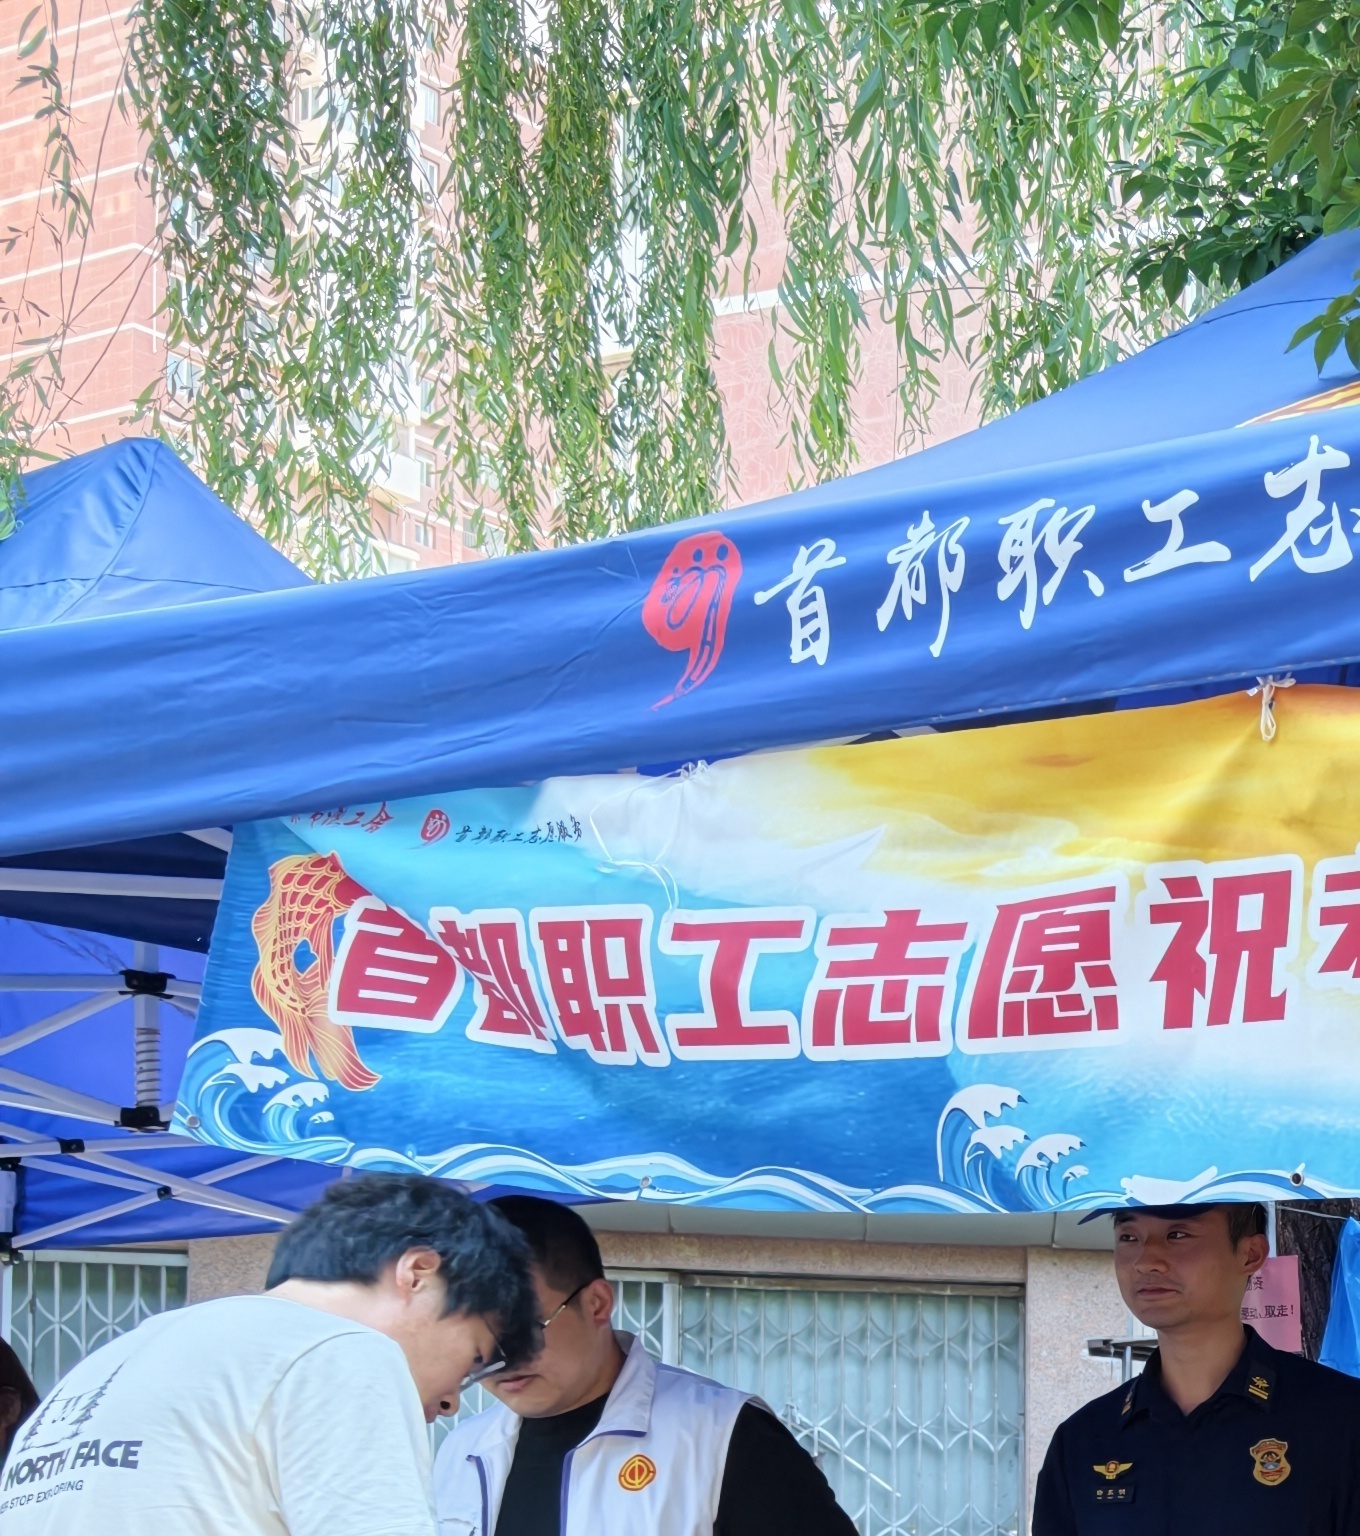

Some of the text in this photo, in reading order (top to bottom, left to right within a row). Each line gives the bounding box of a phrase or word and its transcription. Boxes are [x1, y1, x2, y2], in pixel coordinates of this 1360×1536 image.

[4, 1438, 143, 1491] NORTH FACE
[9, 1493, 34, 1509] STOP
